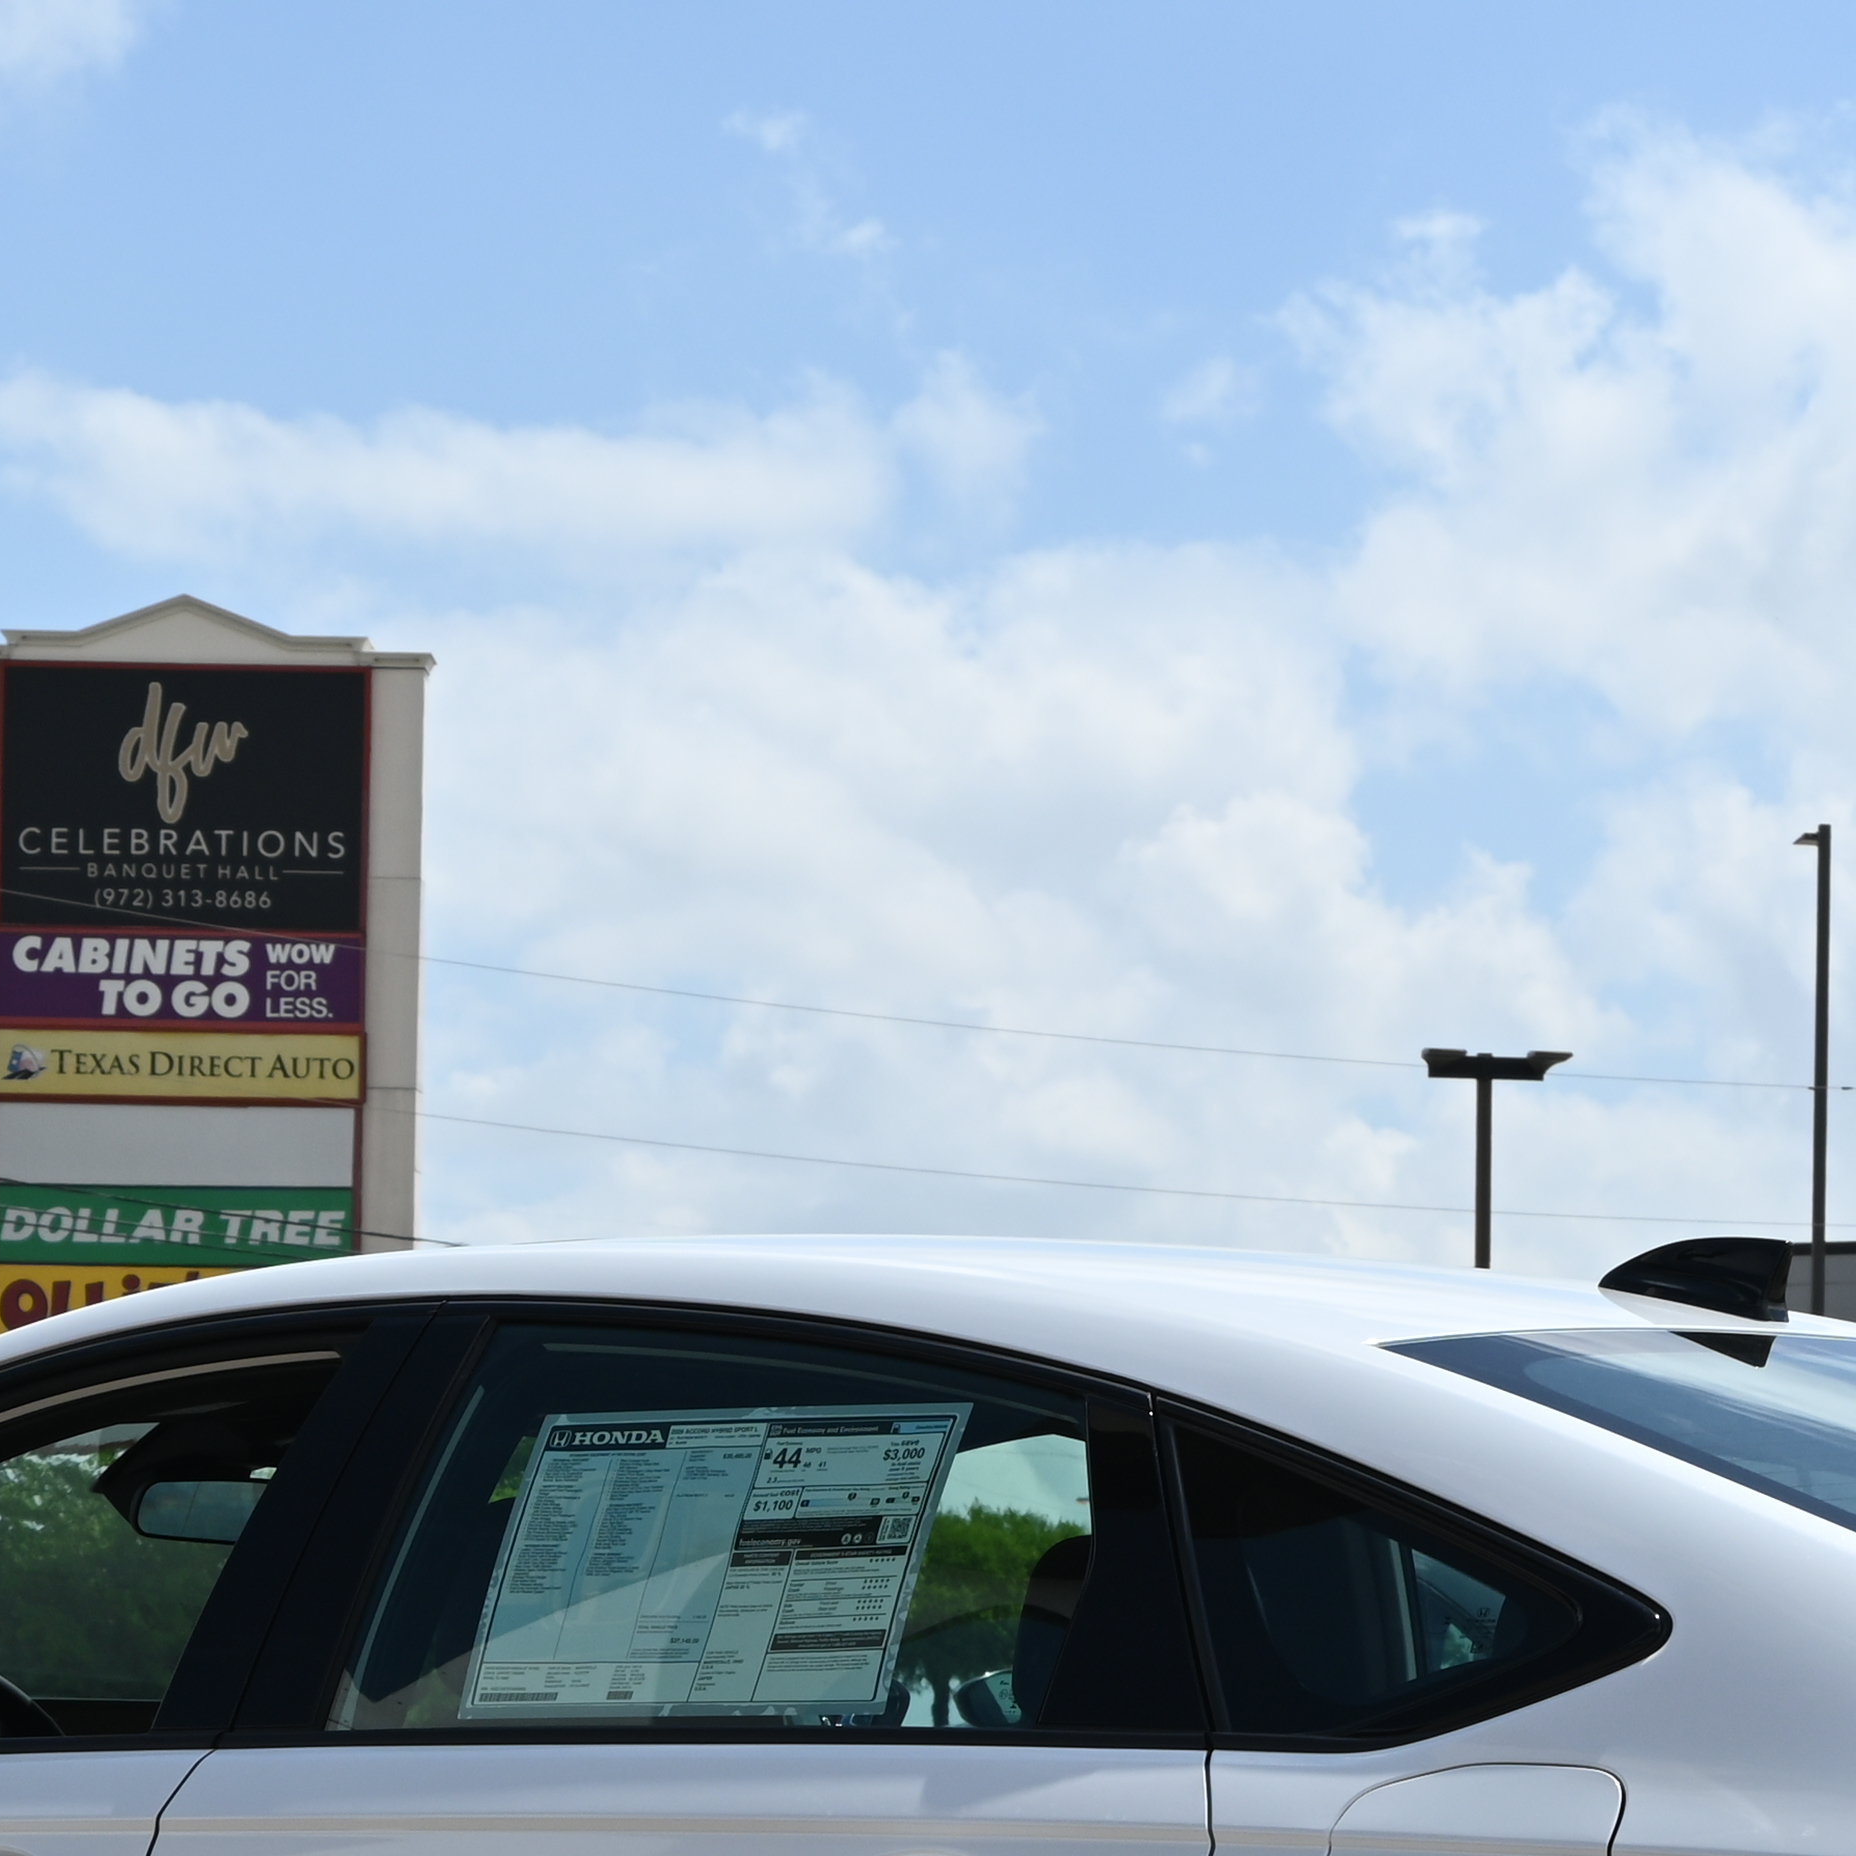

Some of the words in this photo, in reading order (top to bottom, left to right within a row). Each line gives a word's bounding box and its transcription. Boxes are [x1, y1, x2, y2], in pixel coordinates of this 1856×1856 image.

[119, 682, 248, 823] dfw
[19, 827, 345, 858] CELEBRATIONS
[87, 862, 208, 881] BANQUET
[218, 865, 279, 881] HALL
[94, 889, 153, 909] (972)
[161, 890, 272, 909] 313-8686
[12, 935, 251, 976] CABINETS
[266, 943, 335, 965] WOW
[266, 971, 317, 991] FOR
[99, 979, 163, 1018] TO
[171, 980, 251, 1018] GO
[266, 998, 334, 1018] LESS.
[0, 1207, 205, 1245] DOLLAR
[219, 1210, 346, 1247] TREE
[572, 1430, 665, 1446] HONDA
[772, 1447, 803, 1468] 44
[883, 1447, 926, 1461] $3,000
[753, 1499, 794, 1513] $1,100
